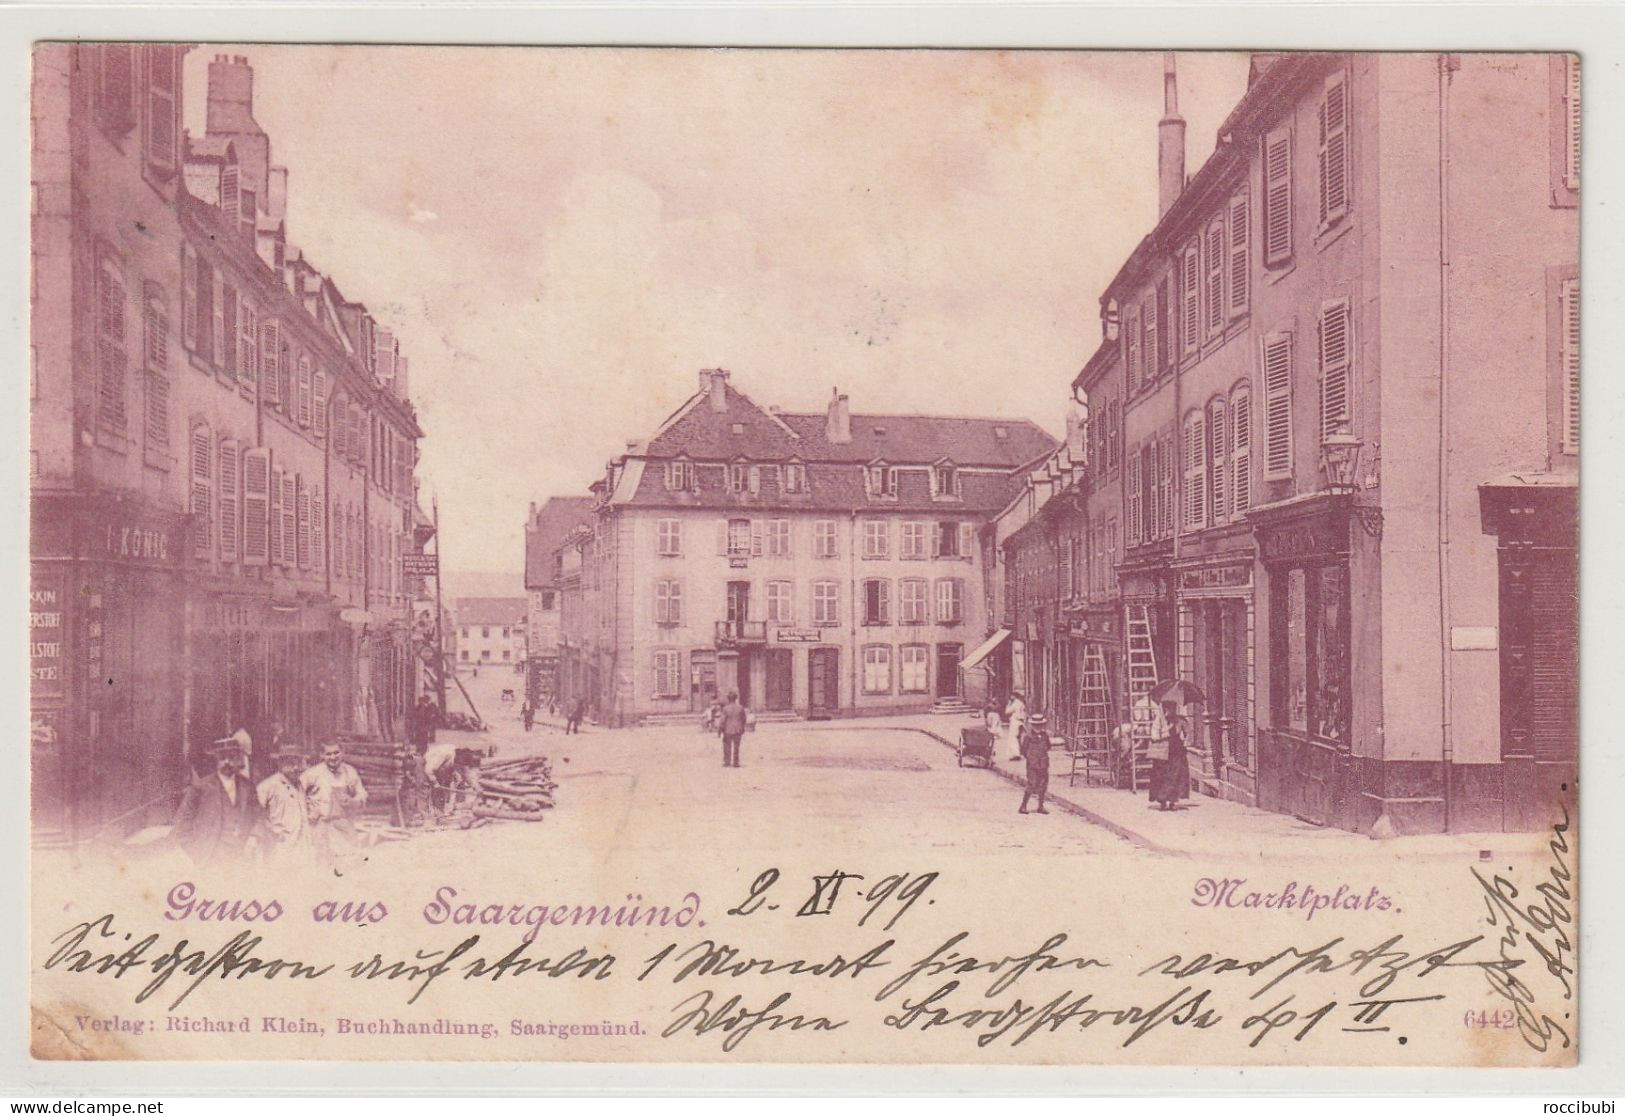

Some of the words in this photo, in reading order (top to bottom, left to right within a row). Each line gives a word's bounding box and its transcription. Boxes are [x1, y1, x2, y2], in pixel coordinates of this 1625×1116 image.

[163, 881, 284, 922] Gruss
[312, 900, 388, 923] aus
[422, 885, 706, 943] Saargemünd.
[1192, 877, 1403, 920] Marktplatz.
[346, 934, 481, 1005] auf
[75, 1014, 154, 1035] Verlag:
[166, 1014, 251, 1033] Richard
[261, 1014, 324, 1036] Klein,
[336, 1016, 498, 1040] Buchhandlung,
[510, 1018, 647, 1037] Saargemünd.
